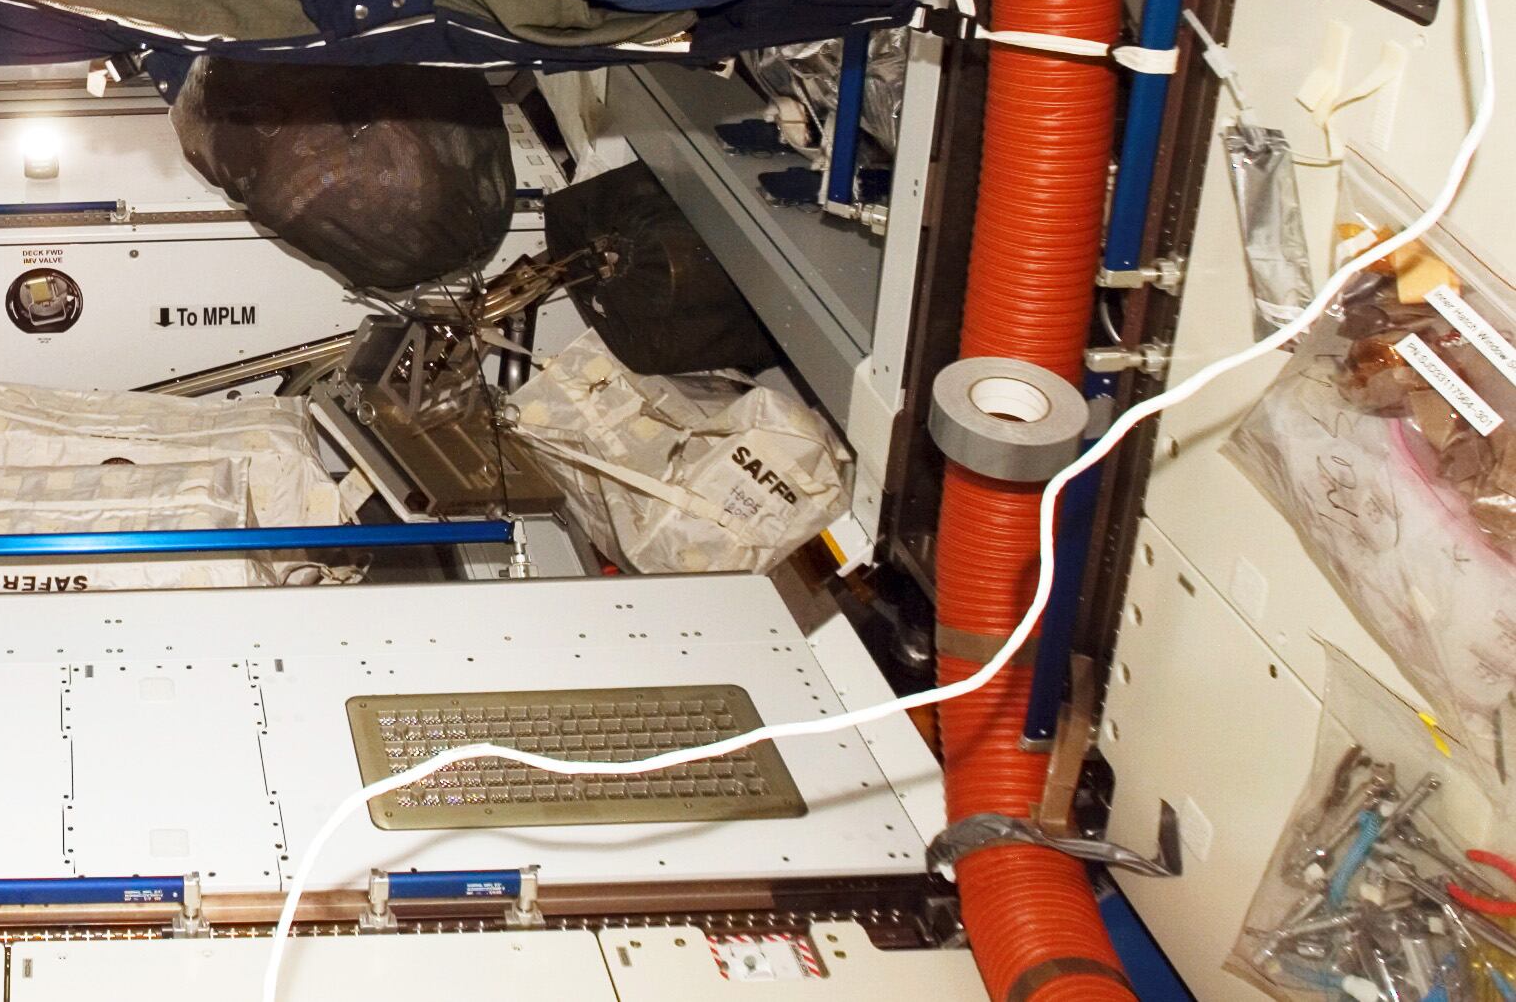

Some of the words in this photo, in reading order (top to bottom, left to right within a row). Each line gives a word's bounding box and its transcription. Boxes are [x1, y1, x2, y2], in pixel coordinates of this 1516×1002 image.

[22, 249, 44, 257] DECK
[23, 257, 37, 265] IMV
[38, 256, 63, 264] VALVE
[176, 307, 198, 326] To
[203, 306, 256, 326] MPLM
[3, 575, 88, 592] SAFER
